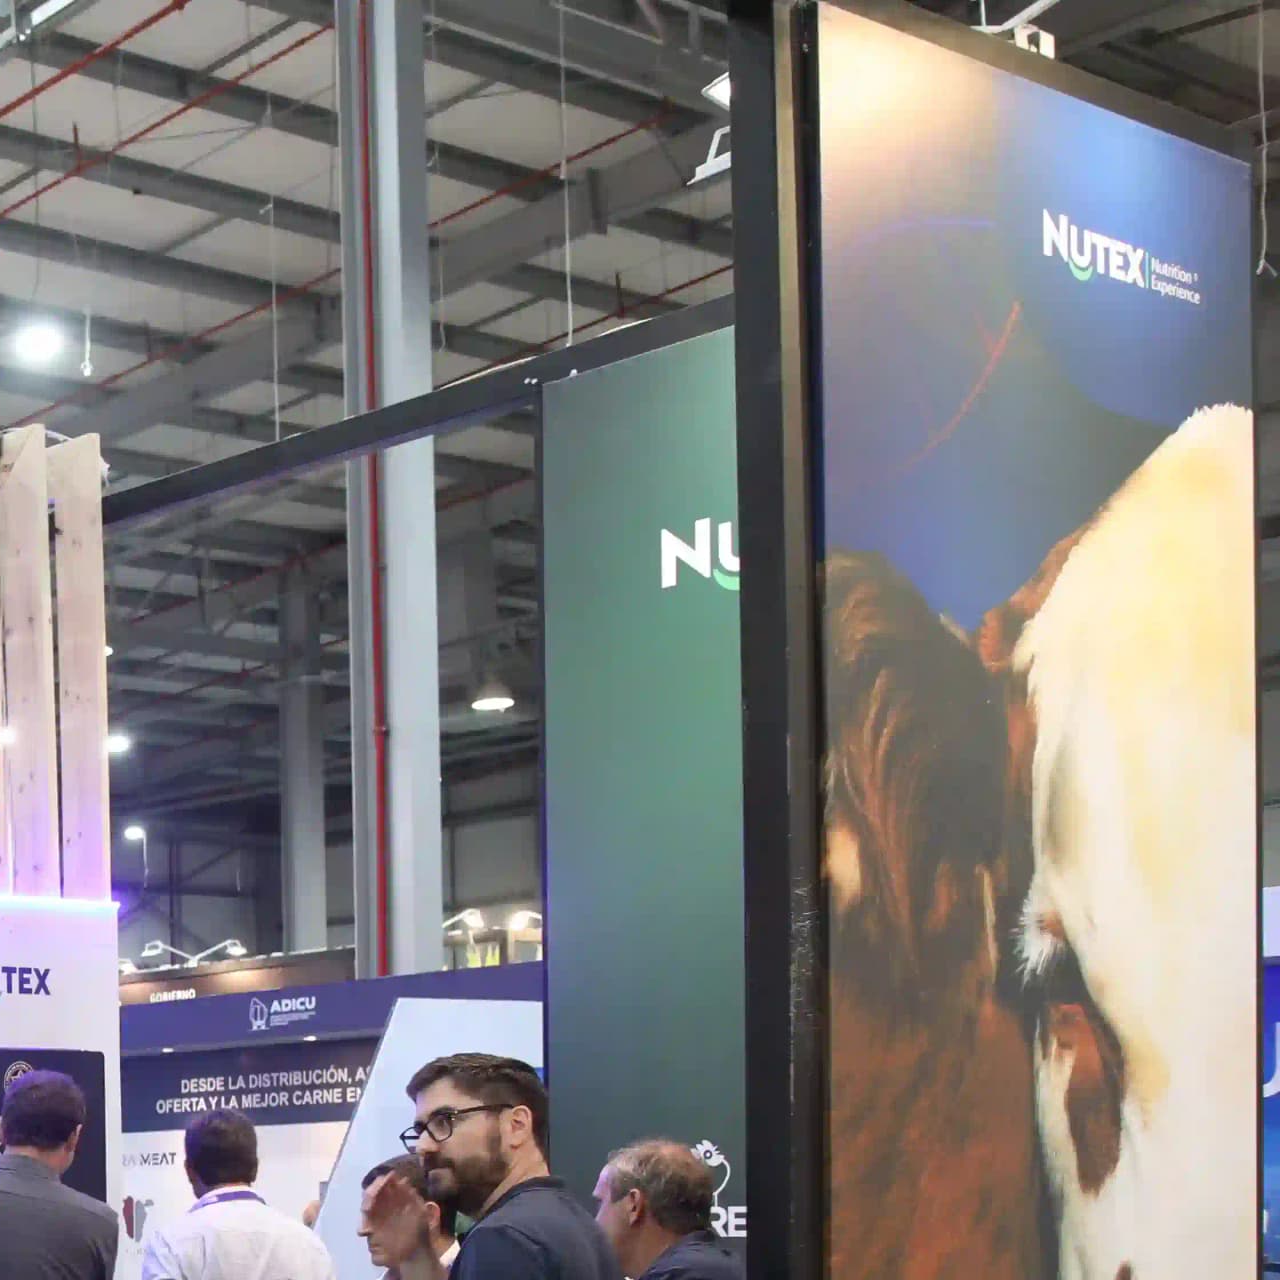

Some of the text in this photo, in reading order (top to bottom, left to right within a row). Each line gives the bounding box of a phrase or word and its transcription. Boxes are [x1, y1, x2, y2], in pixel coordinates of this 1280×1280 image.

[1043, 208, 1144, 288] NUTEX
[1151, 256, 1192, 284] Nutrition
[1151, 274, 1200, 304] Experience
[270, 996, 316, 1013] ADICU
[181, 1076, 224, 1093] DESDE
[228, 1074, 245, 1091] LA
[156, 1097, 207, 1114] OFERTA
[209, 1096, 219, 1111] Y
[221, 1095, 238, 1110] LA
[242, 1091, 289, 1109] MEJOR
[293, 1088, 342, 1105] CARNE
